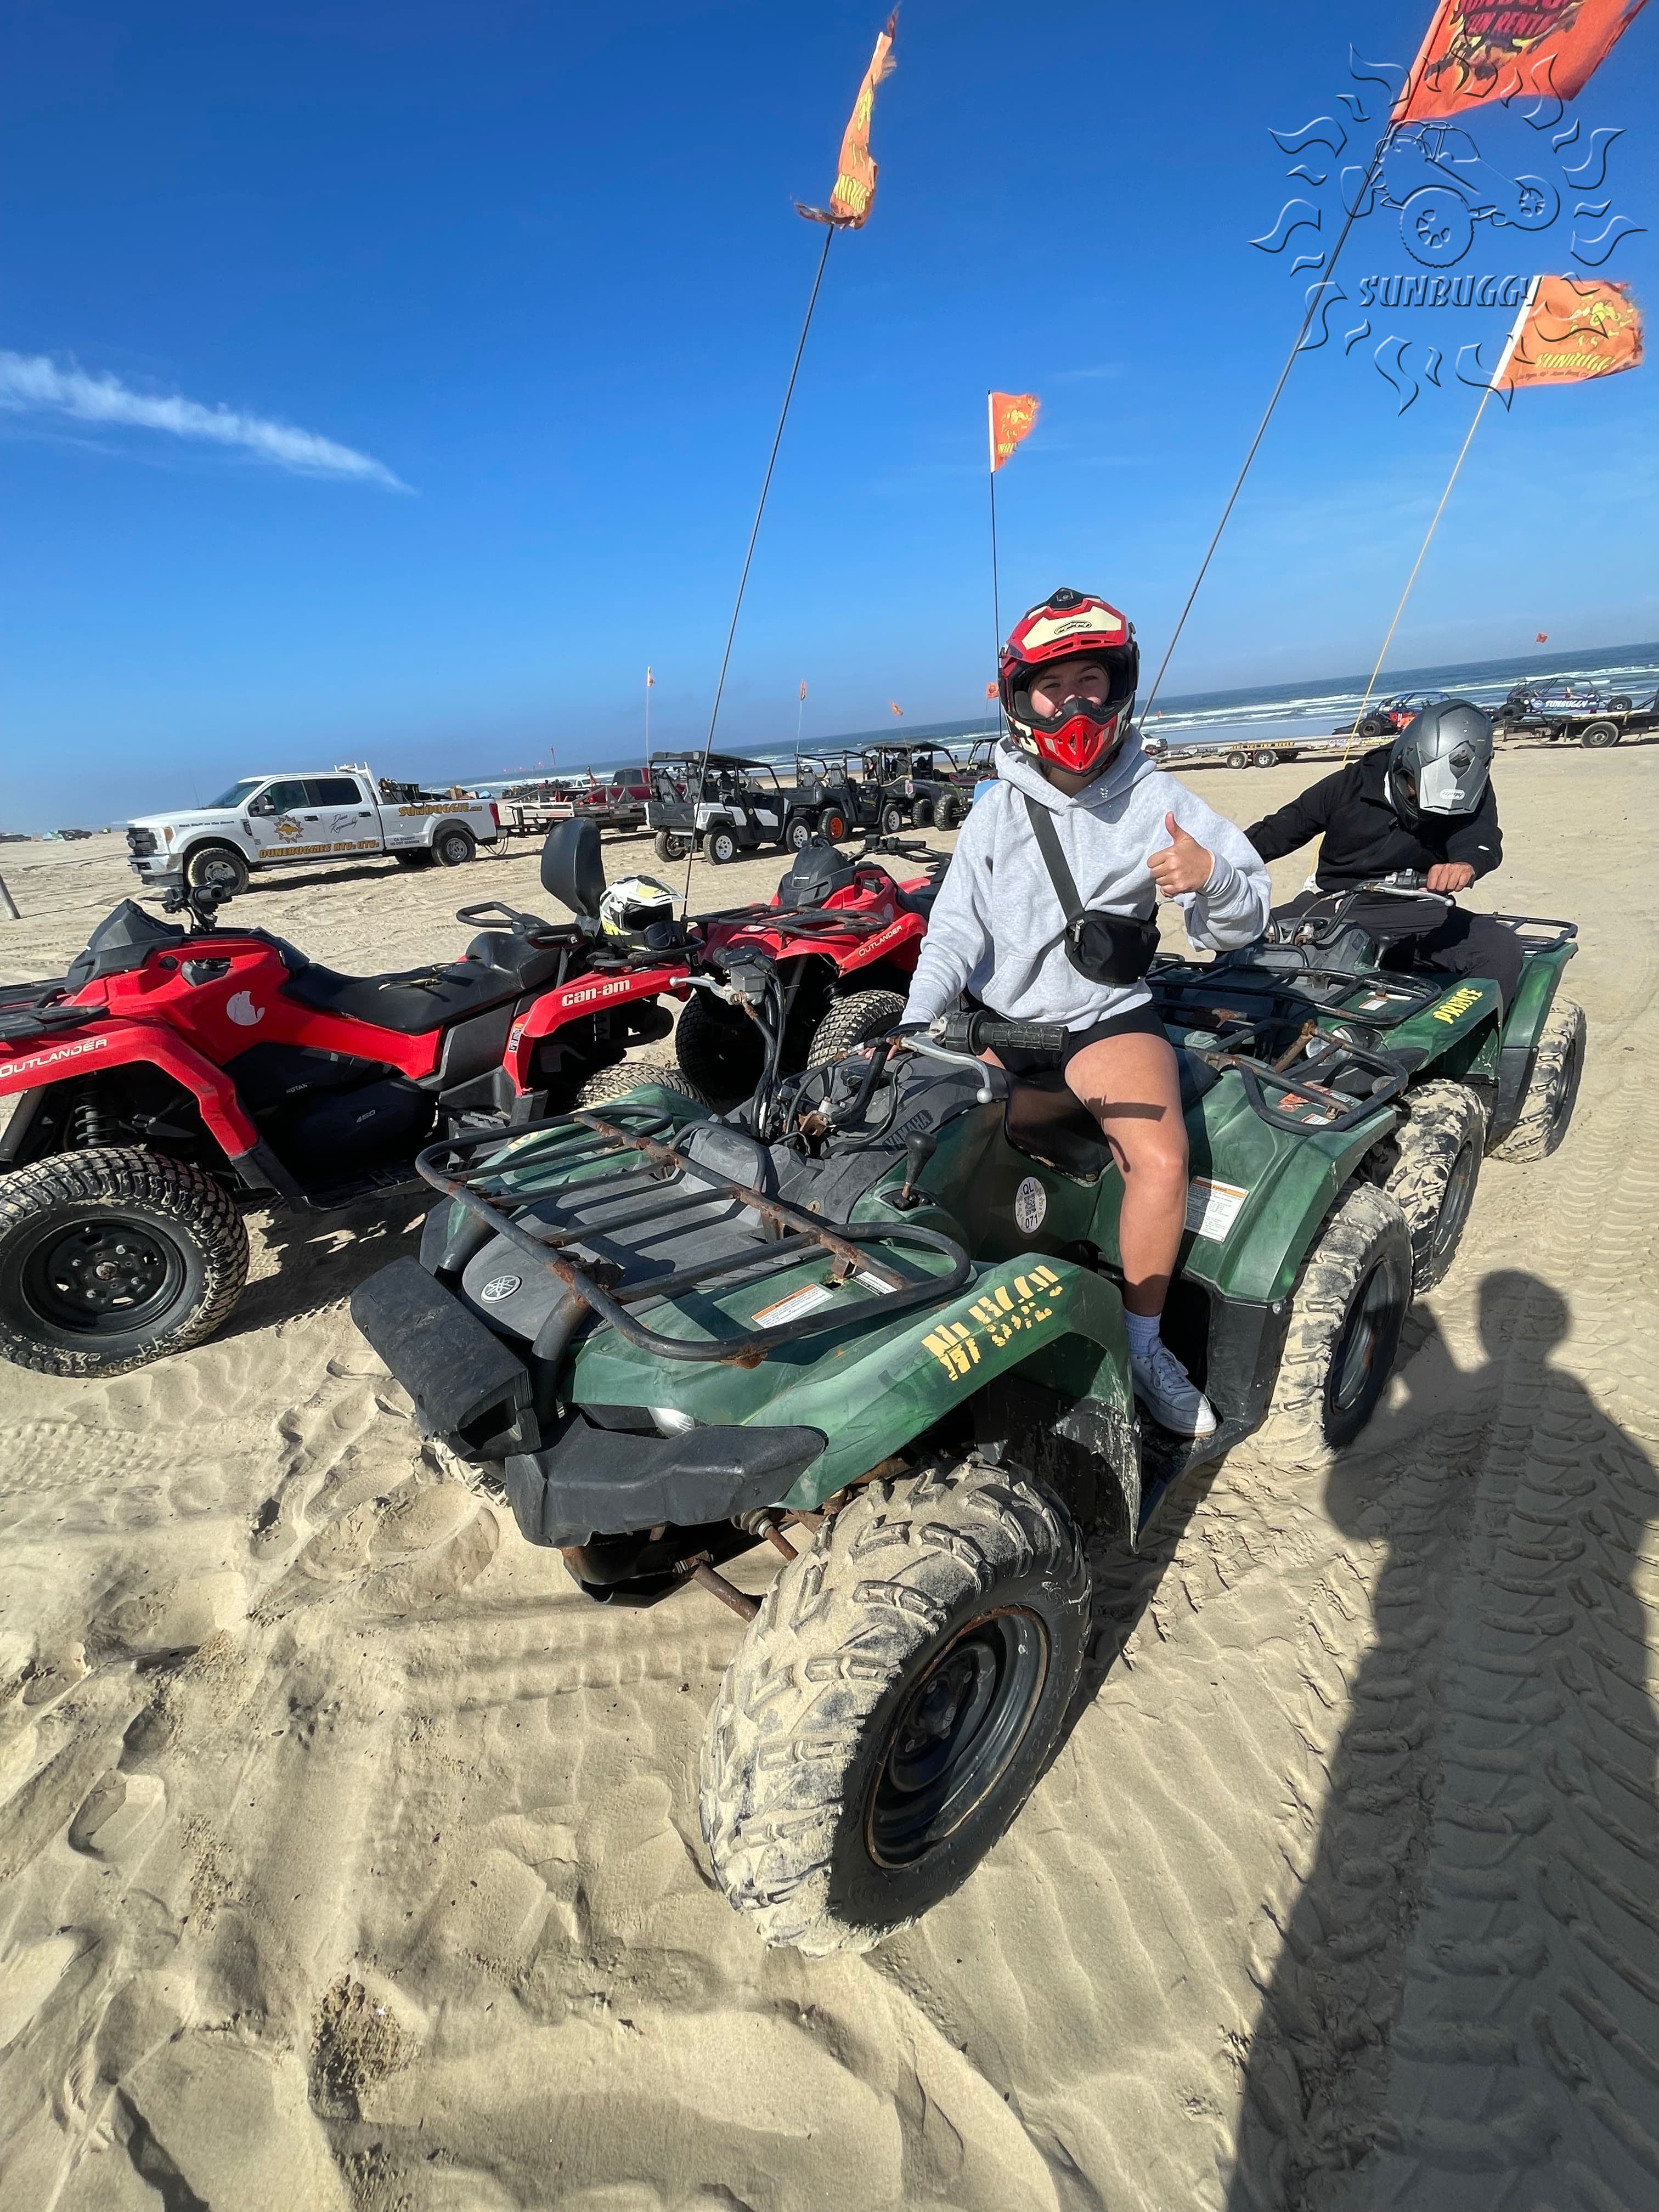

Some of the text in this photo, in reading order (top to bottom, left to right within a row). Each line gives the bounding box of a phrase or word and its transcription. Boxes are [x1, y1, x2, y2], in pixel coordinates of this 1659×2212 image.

[1545, 699, 1589, 708] SUNBUGGY
[859, 925, 902, 957] OUTLANDER
[561, 979, 630, 1007] can-am
[0, 1038, 108, 1079] OUTLANDER
[356, 1109, 376, 1123] 450
[1023, 1182, 1034, 1195] QL
[1025, 1214, 1038, 1229] 071
